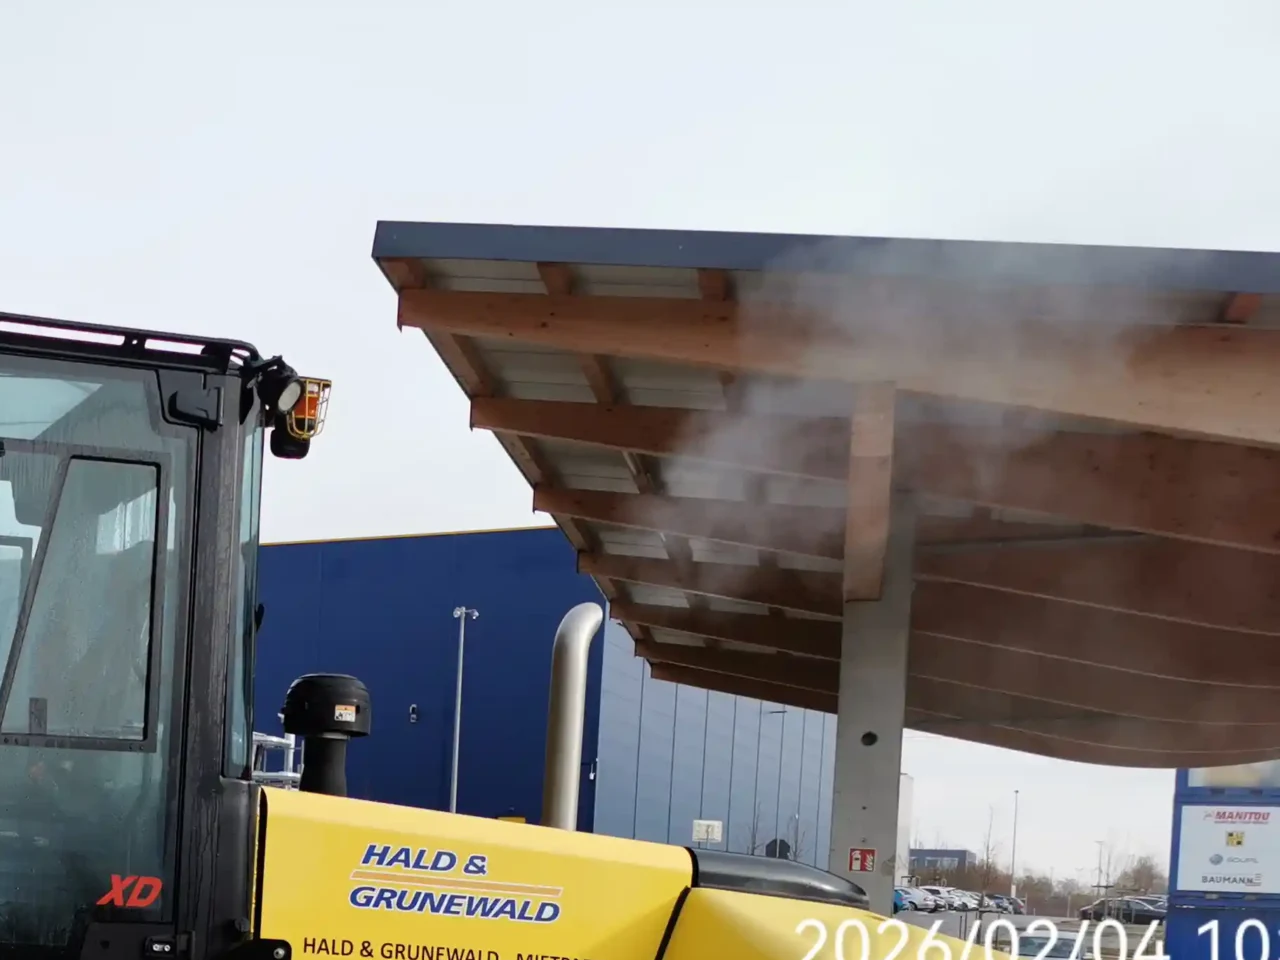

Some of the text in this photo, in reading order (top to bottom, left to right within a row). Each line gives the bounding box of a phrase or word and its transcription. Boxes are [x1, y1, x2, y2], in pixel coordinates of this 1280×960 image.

[1215, 811, 1271, 821] MANITOU
[361, 843, 488, 875] HALD &
[96, 874, 163, 908] XD
[1201, 875, 1254, 885] BAUMANN
[349, 886, 562, 923] GRUNEWALD
[303, 937, 355, 957] HALD
[360, 940, 374, 958] &
